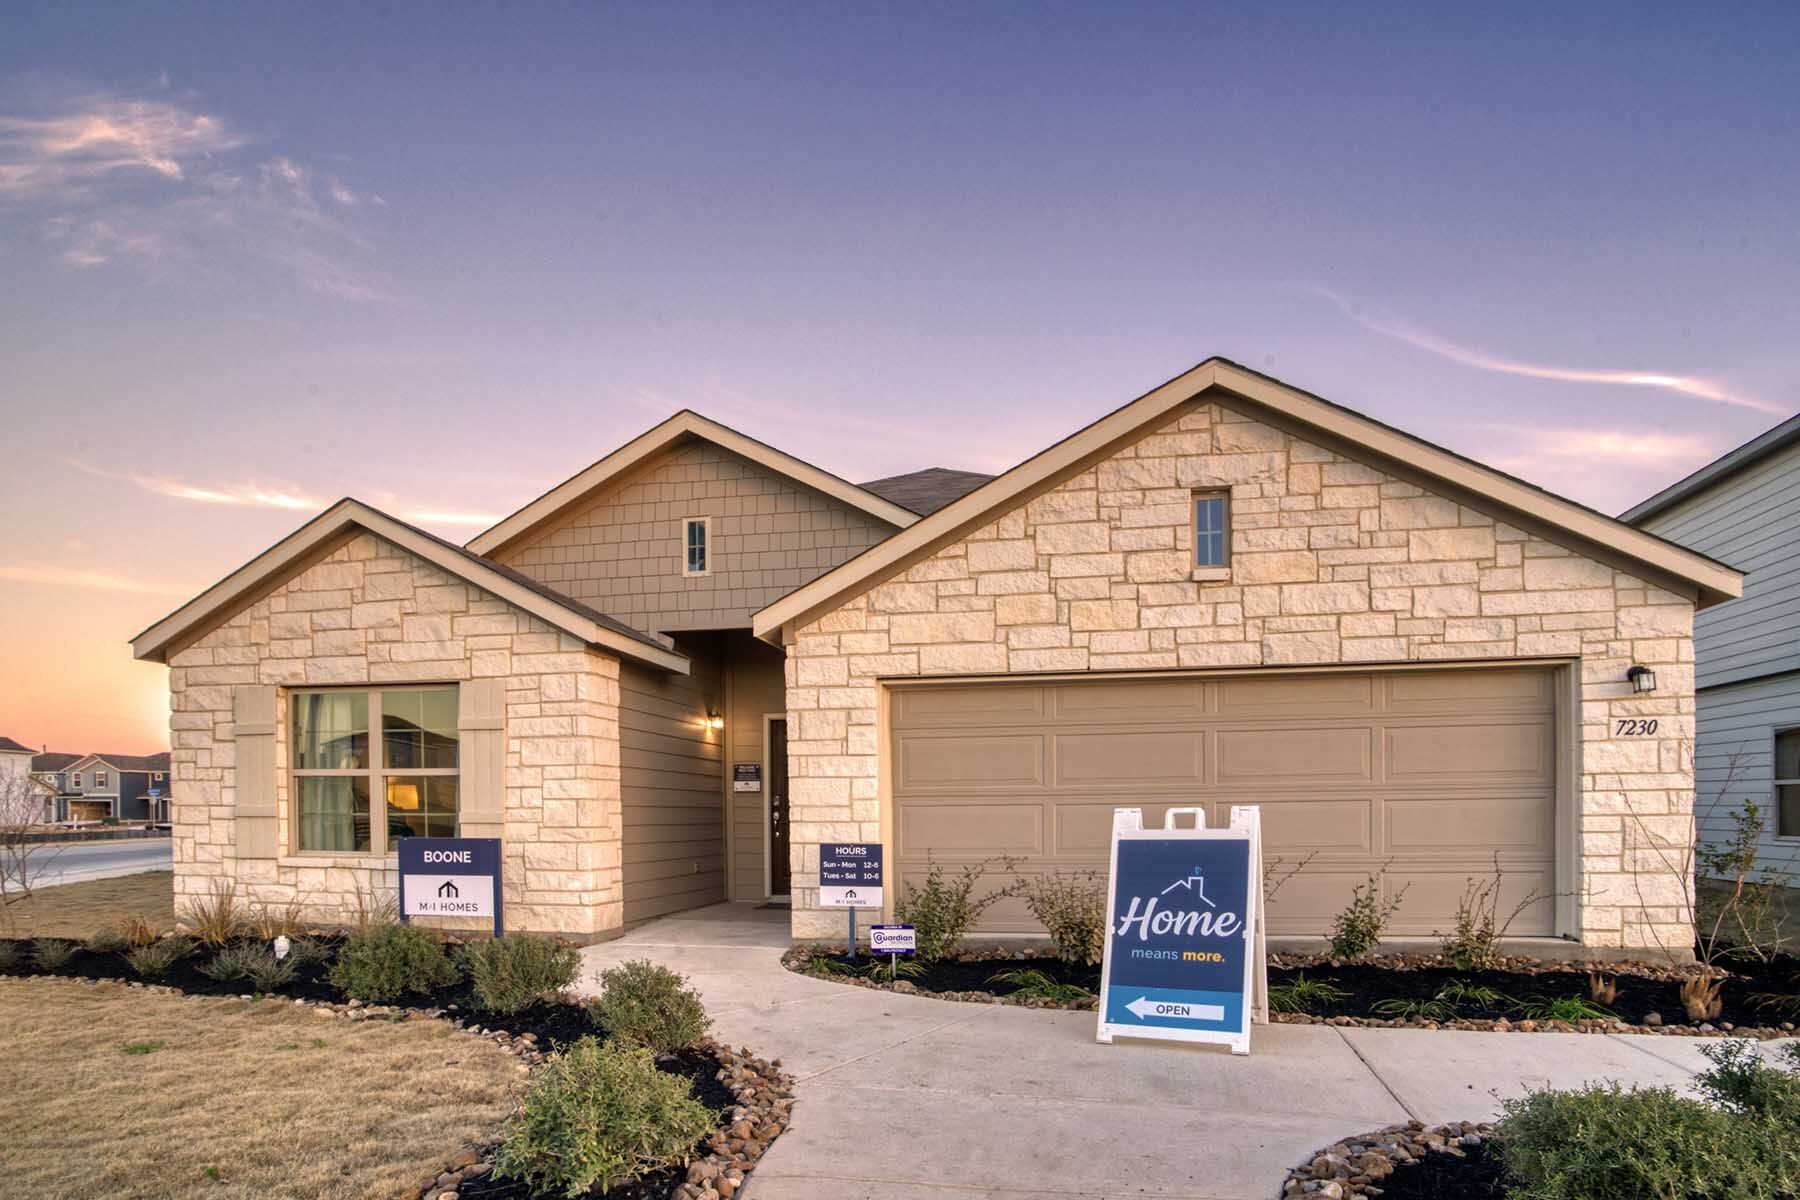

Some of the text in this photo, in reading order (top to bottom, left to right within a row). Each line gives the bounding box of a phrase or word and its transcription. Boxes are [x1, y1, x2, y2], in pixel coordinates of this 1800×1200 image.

[1616, 719, 1658, 736] 7230
[424, 851, 472, 863] BOONE
[835, 847, 867, 855] HOURS
[440, 903, 479, 912] HOMES
[1117, 896, 1241, 941] Home
[1131, 949, 1225, 963] means more.
[1156, 1004, 1190, 1016] OPEN
